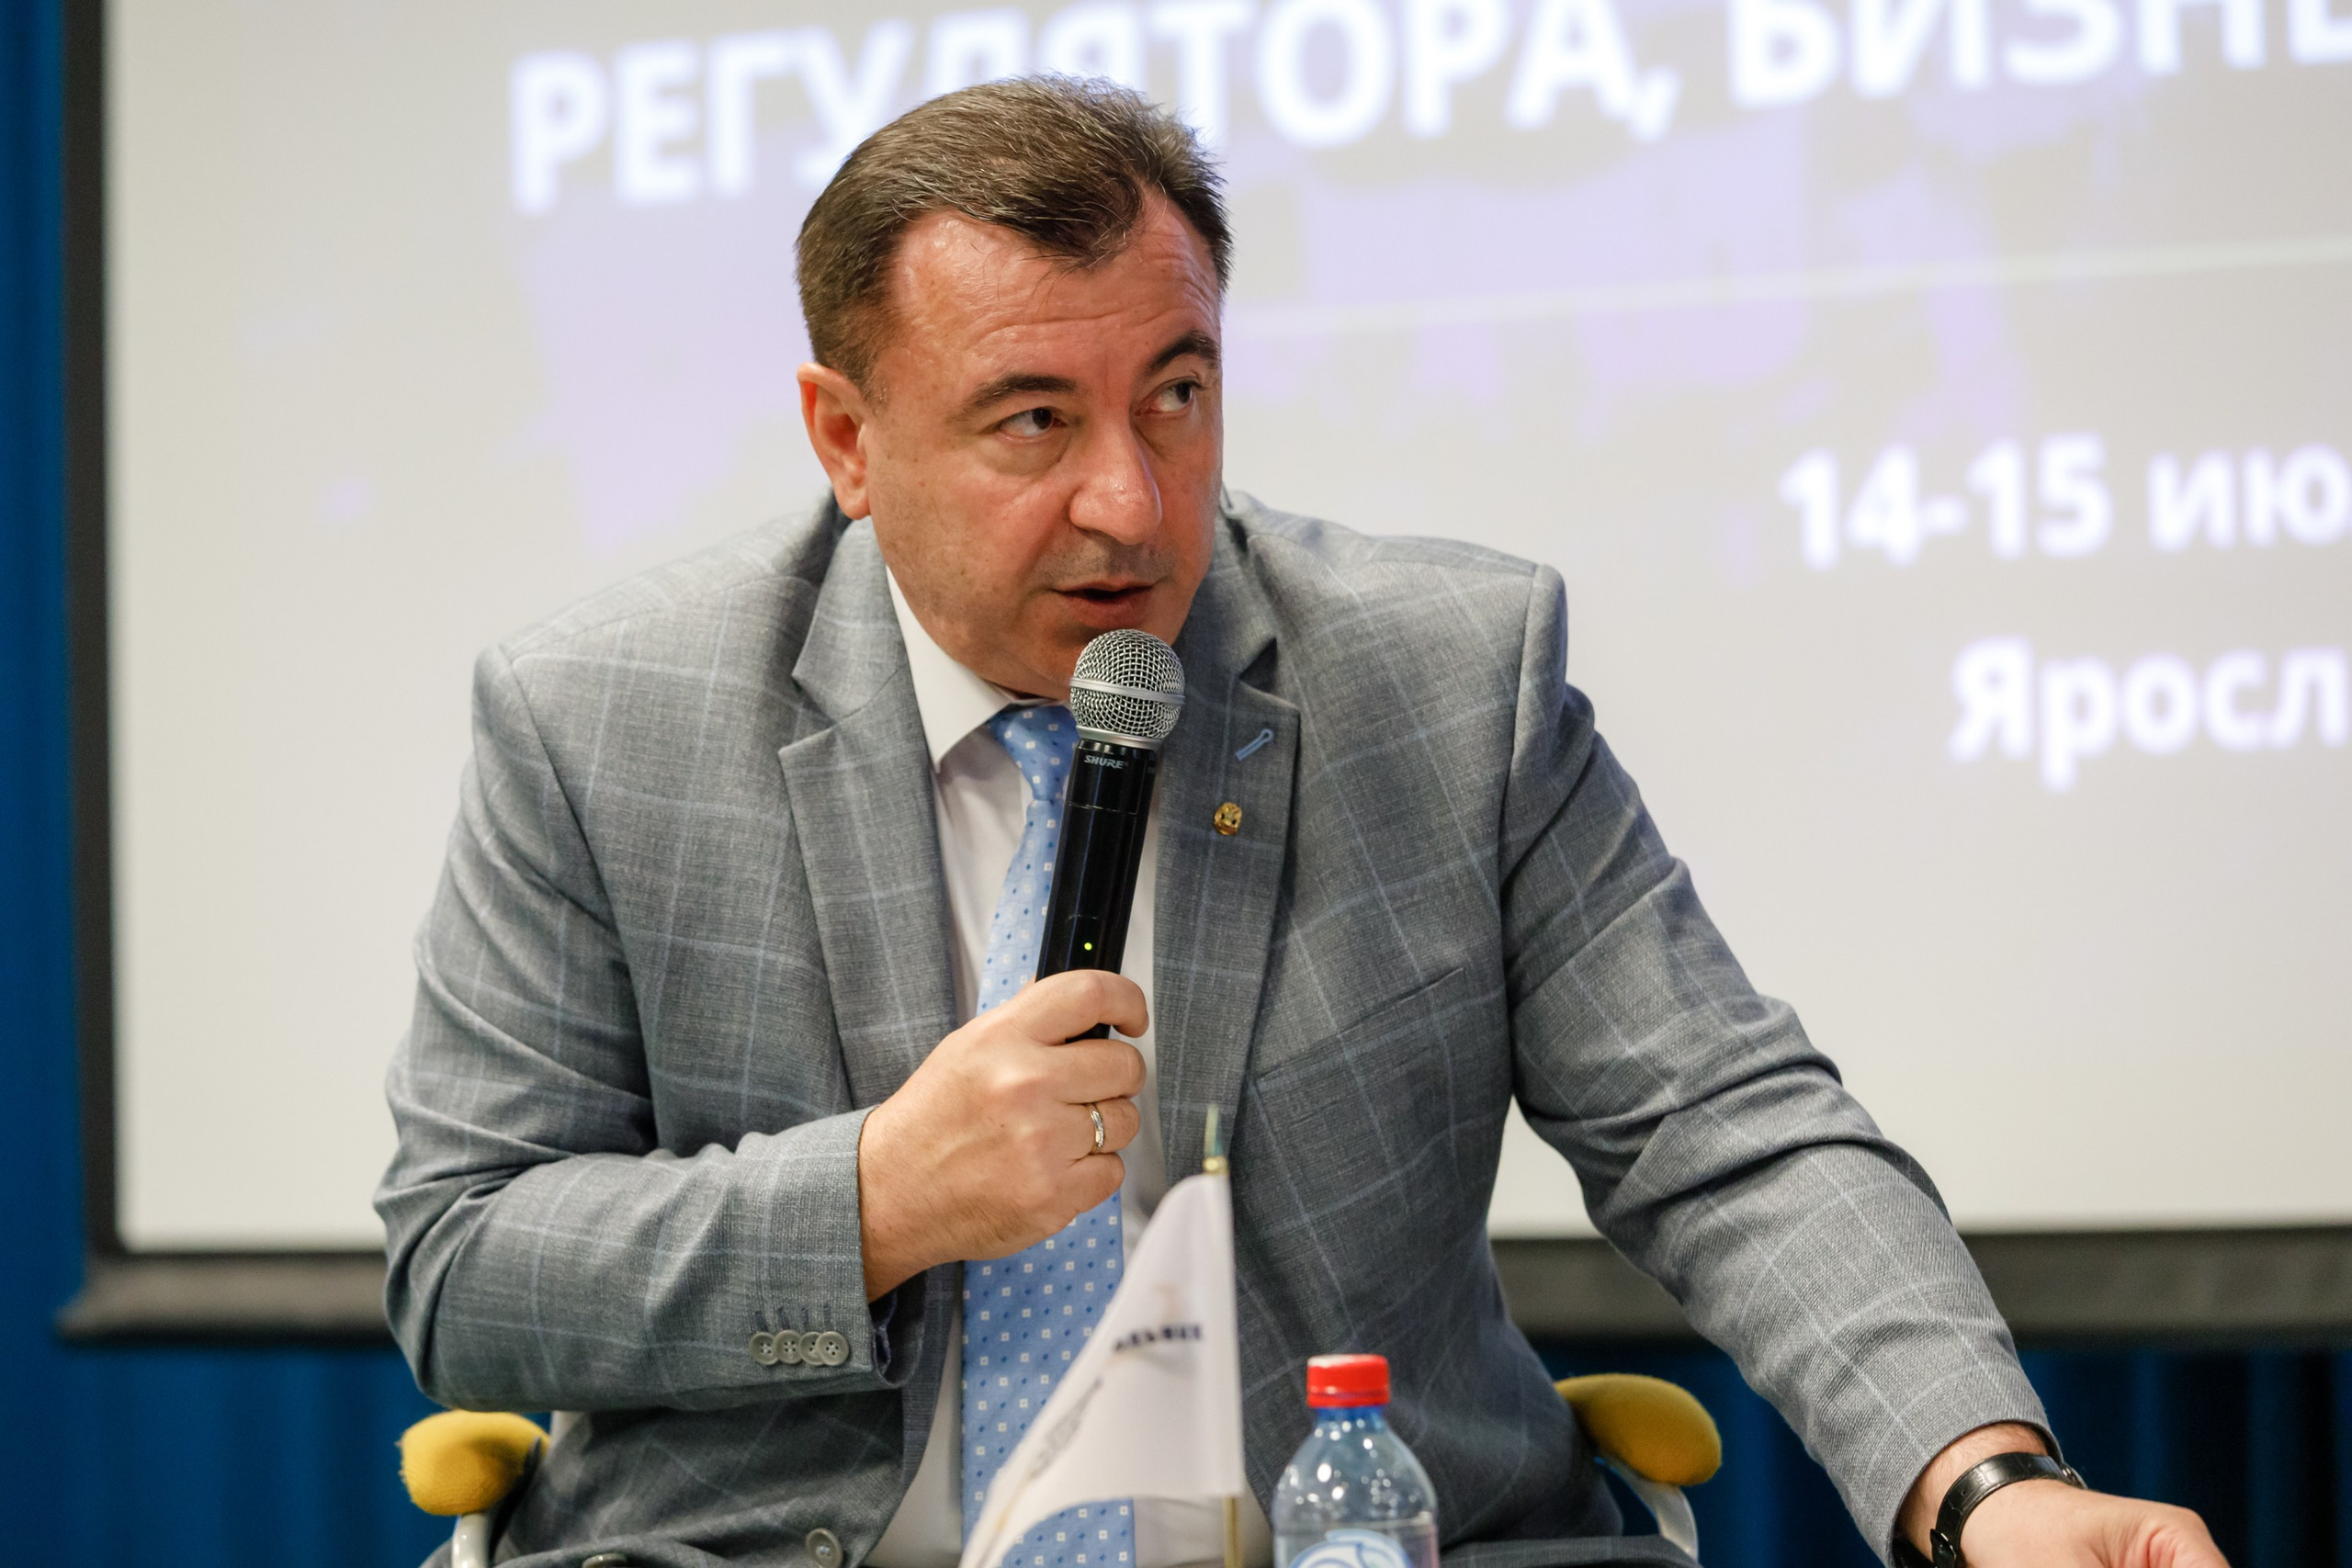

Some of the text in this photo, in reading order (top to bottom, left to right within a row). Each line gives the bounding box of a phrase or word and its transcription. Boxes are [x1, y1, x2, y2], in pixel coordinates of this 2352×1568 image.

[1776, 434, 2114, 571] 14-15
[1084, 754, 1125, 770] SHURE
[1944, 636, 2349, 794] Яросл
